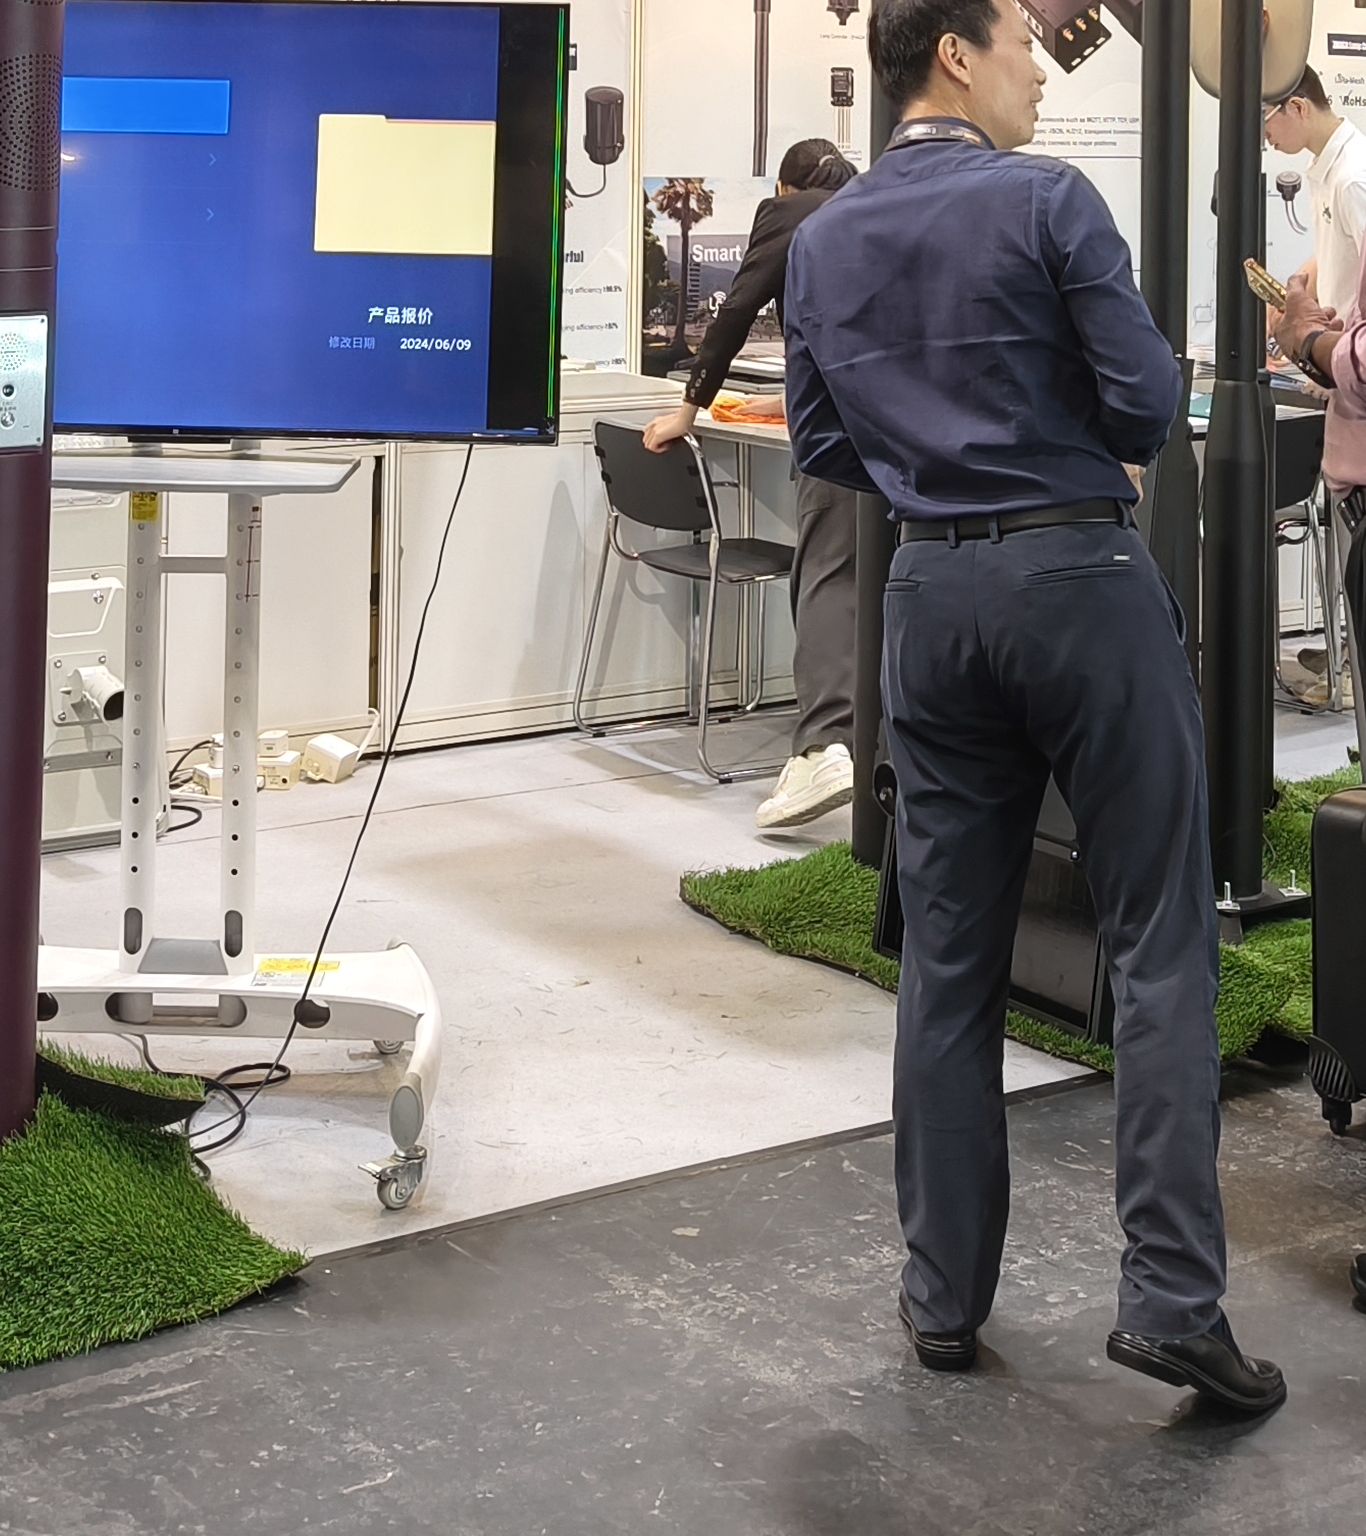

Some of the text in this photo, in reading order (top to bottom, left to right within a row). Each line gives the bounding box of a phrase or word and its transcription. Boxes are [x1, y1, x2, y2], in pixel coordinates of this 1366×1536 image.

[692, 244, 742, 262] Smart
[368, 307, 433, 325] 产品报价
[329, 336, 471, 351] 修改日期 2024/06/09
